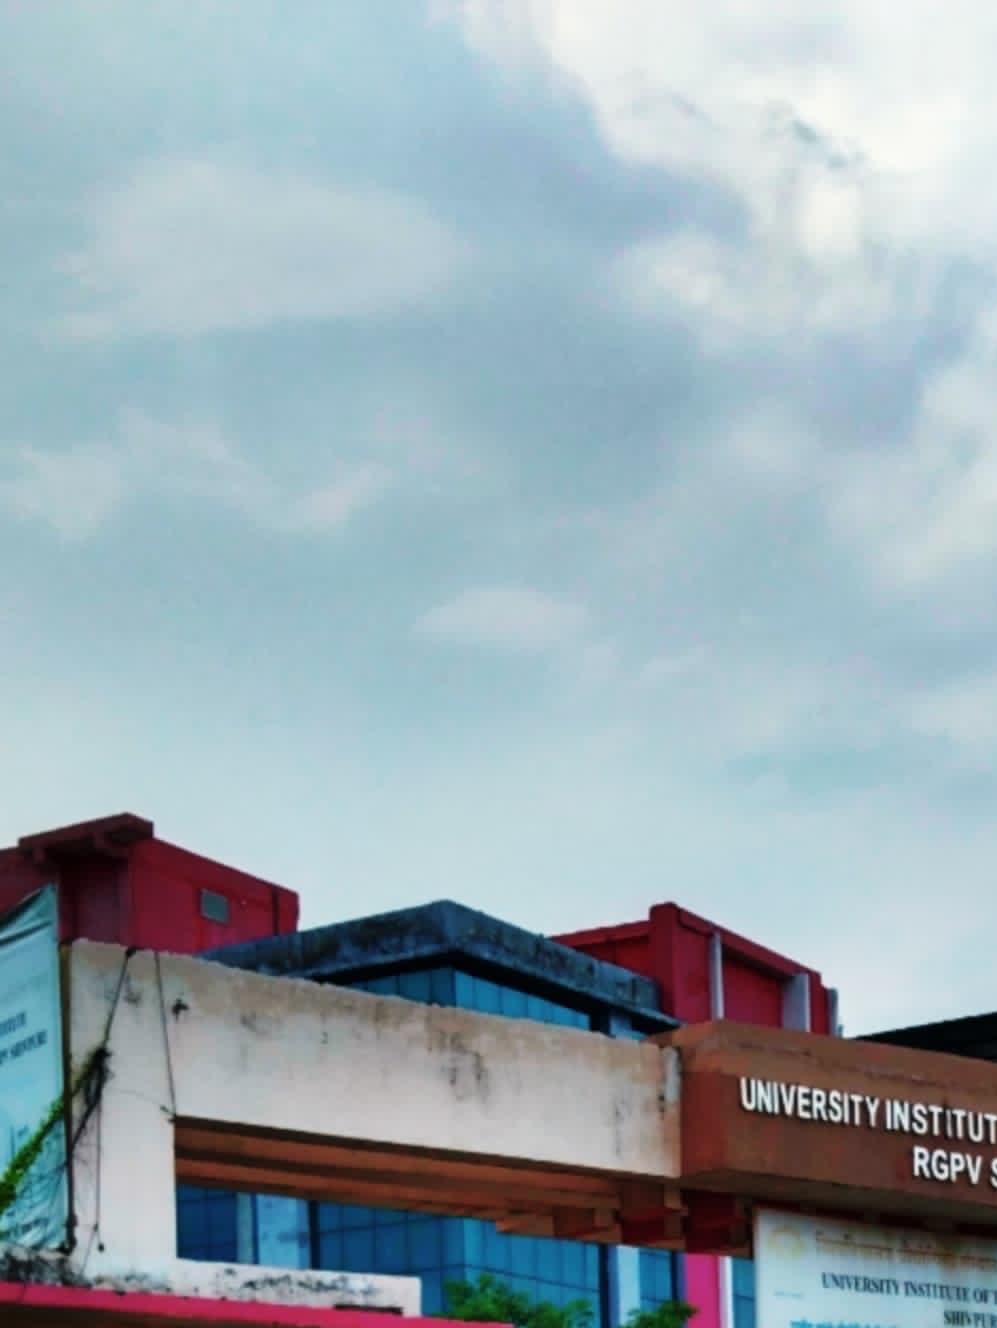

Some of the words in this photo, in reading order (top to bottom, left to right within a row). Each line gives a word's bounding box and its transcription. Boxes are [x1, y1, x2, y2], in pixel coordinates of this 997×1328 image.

[740, 1077, 880, 1127] UNIVERSITY
[912, 1145, 982, 1185] RGPV
[821, 1271, 900, 1296] UNIVERSITY
[903, 1280, 969, 1303] INSTITUTE
[972, 1287, 990, 1304] OF
